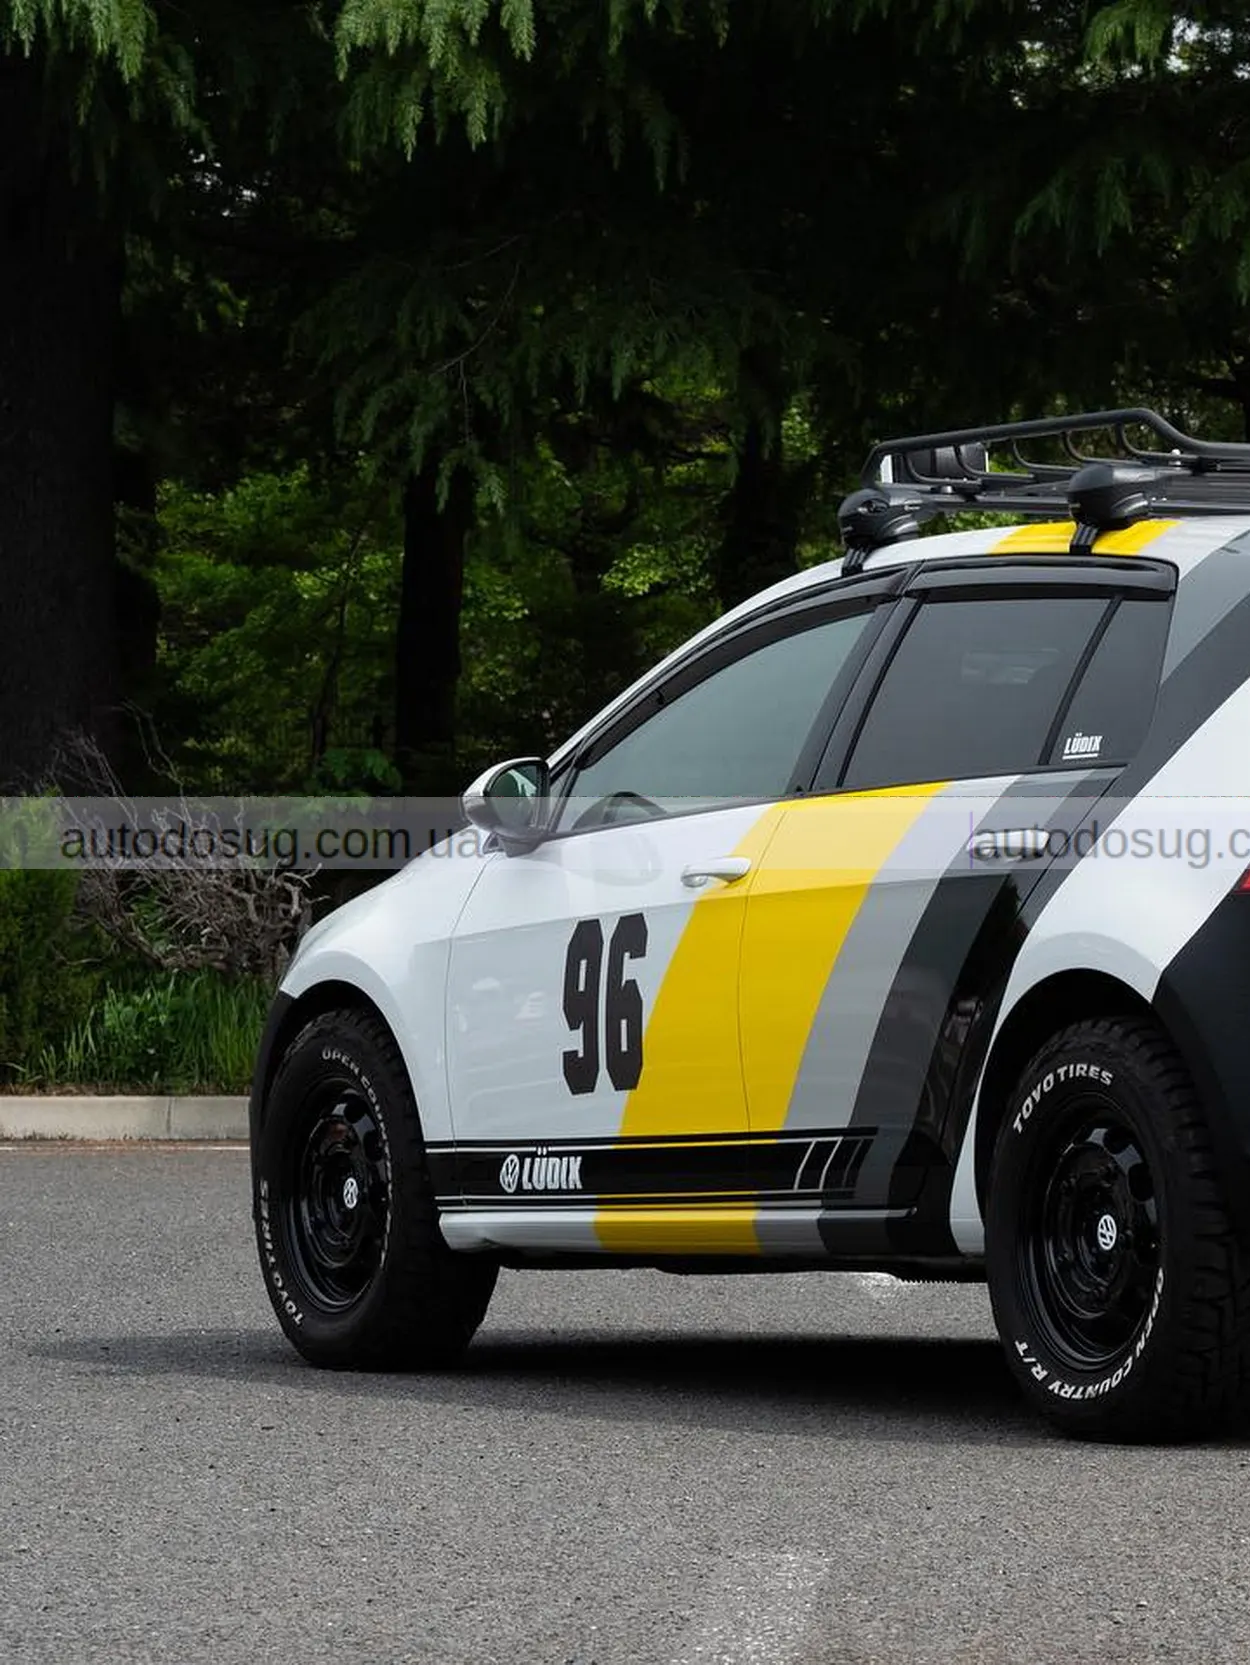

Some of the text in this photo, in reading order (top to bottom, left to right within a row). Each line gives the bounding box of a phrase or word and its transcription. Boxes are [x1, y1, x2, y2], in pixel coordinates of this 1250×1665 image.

[1063, 732, 1103, 754] LÜDIX
[562, 912, 649, 1096] 96
[1012, 1062, 1114, 1134] TOYO TIRES
[522, 1147, 582, 1190] LÜDIX
[1014, 1338, 1046, 1381] R/T
[1047, 1355, 1134, 1400] COUNTRY
